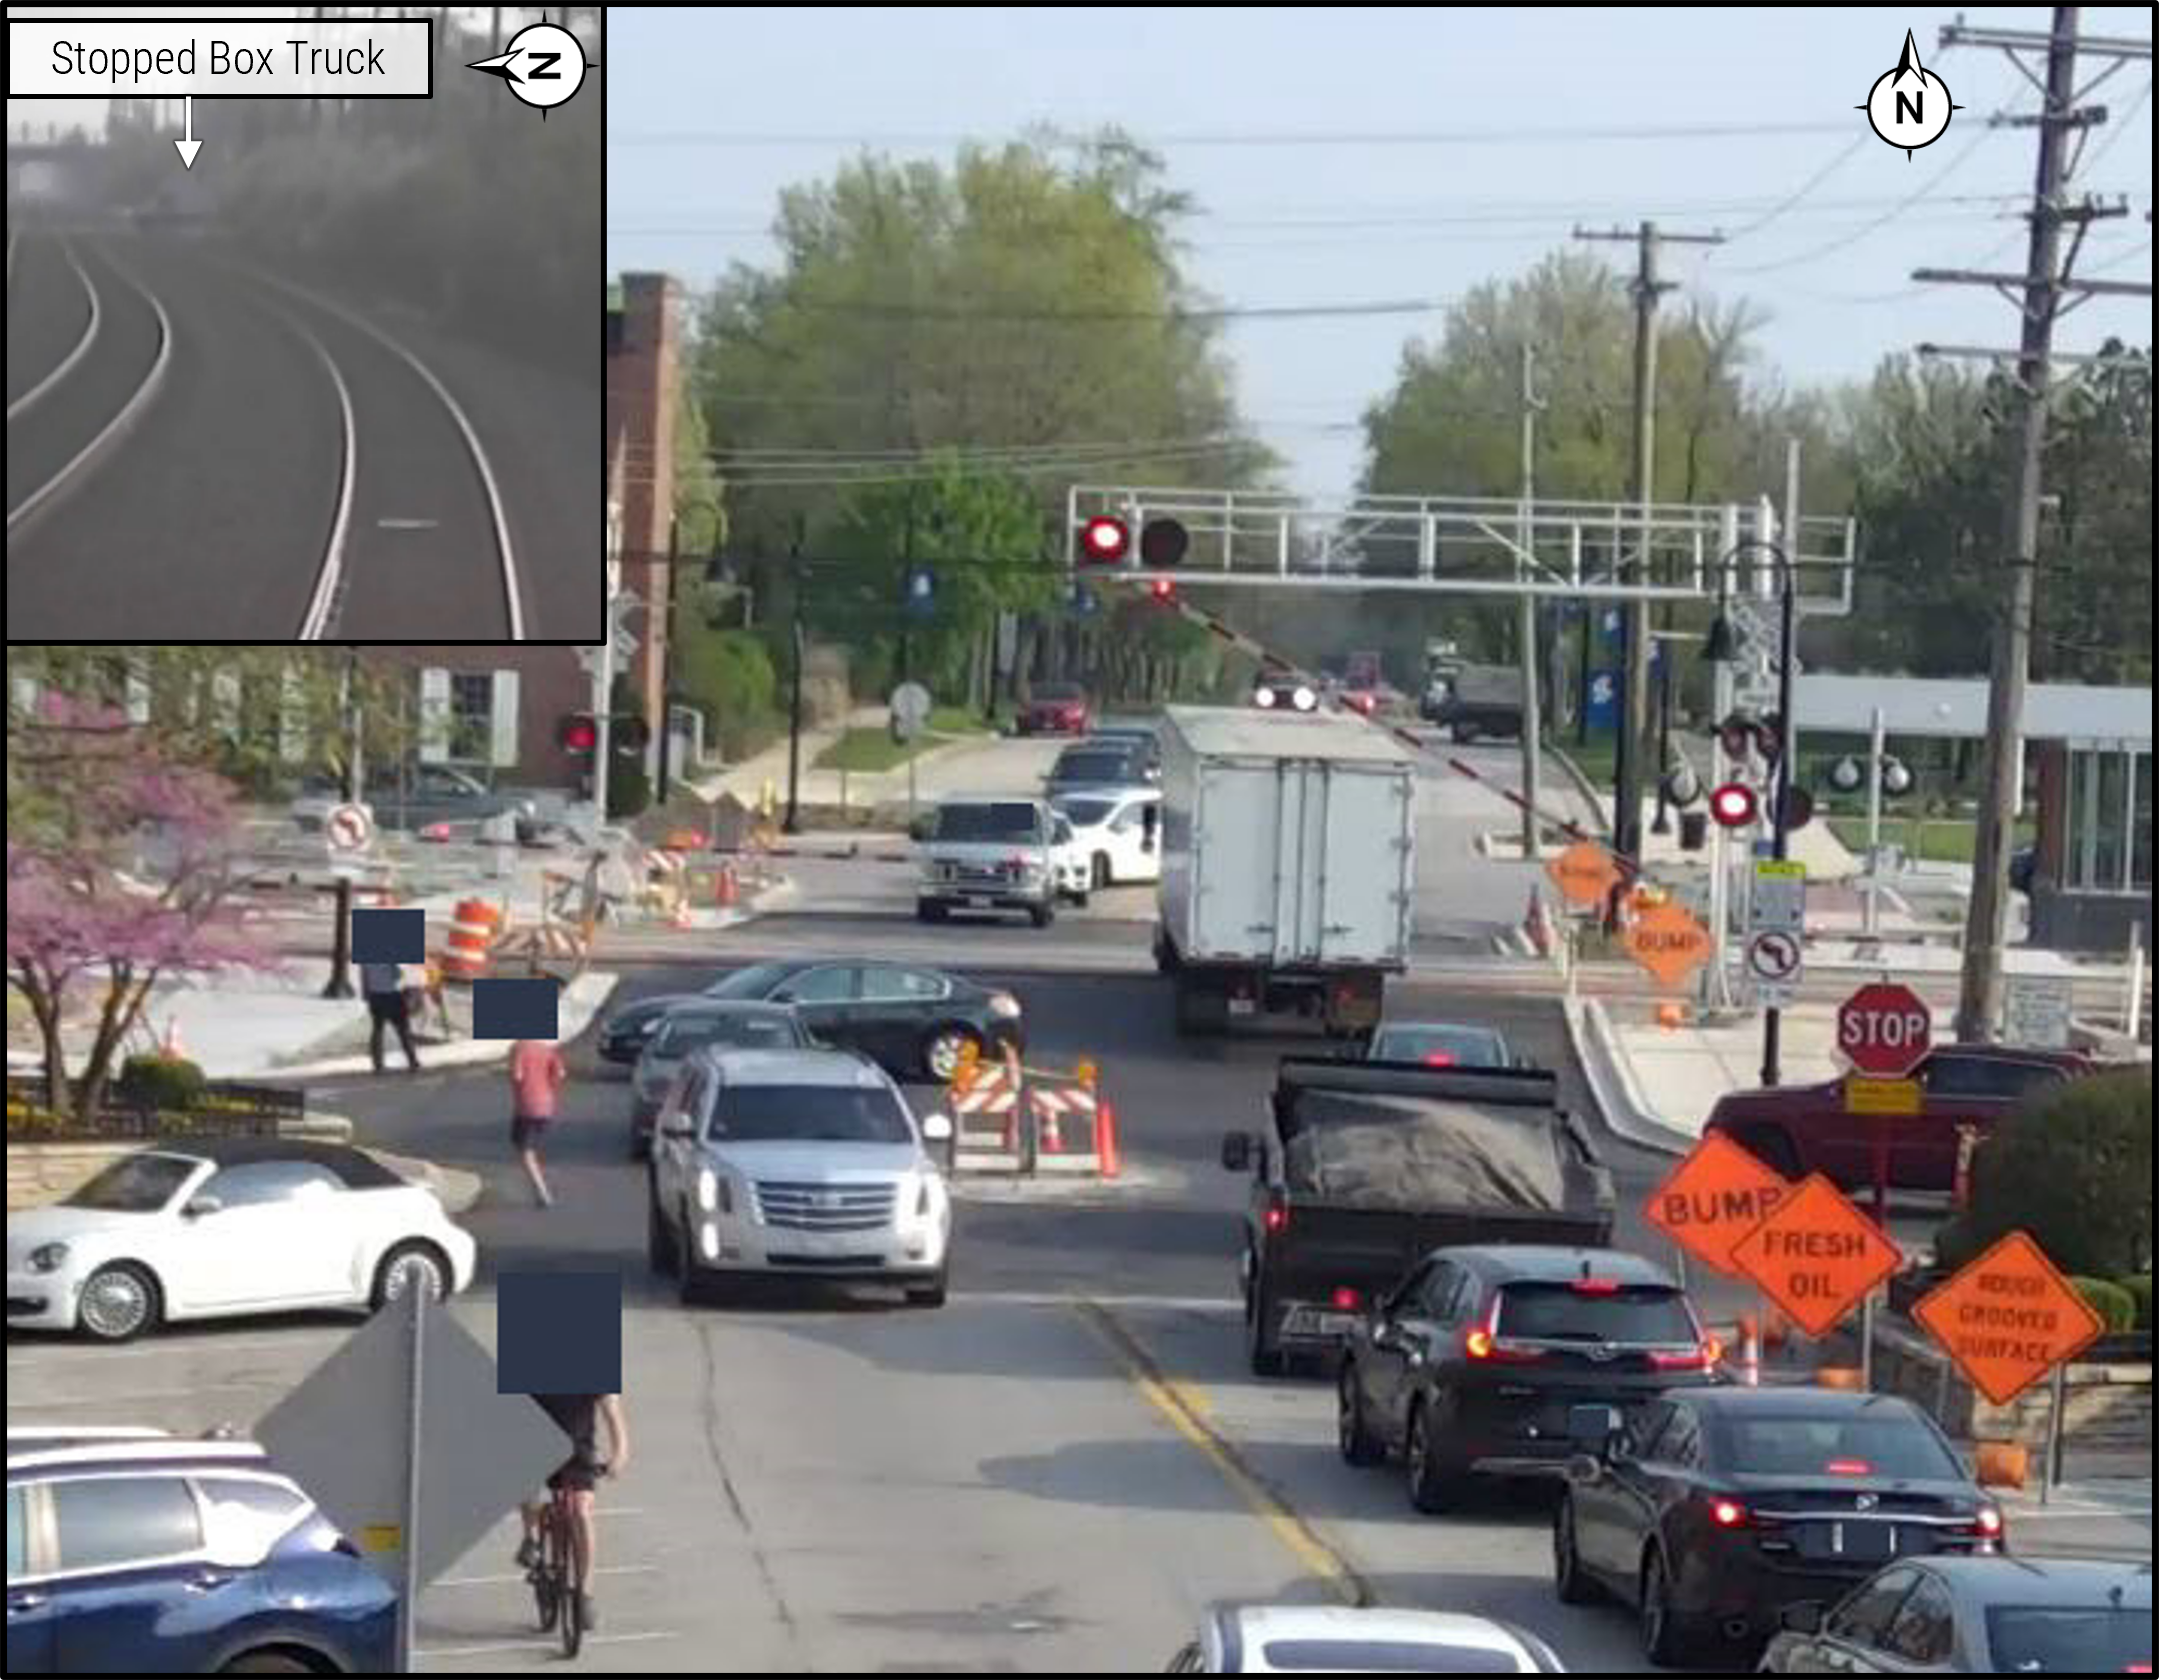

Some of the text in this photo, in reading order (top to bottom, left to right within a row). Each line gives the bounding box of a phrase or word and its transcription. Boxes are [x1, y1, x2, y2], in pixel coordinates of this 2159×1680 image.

[1843, 1010, 1926, 1047] STOP
[1664, 1187, 1783, 1226] BUMP
[1763, 1229, 1867, 1259] FRESH
[1789, 1272, 1842, 1299] OIL
[1959, 1303, 2059, 1332] GROOVED
[1956, 1336, 2053, 1362] SURFACE
